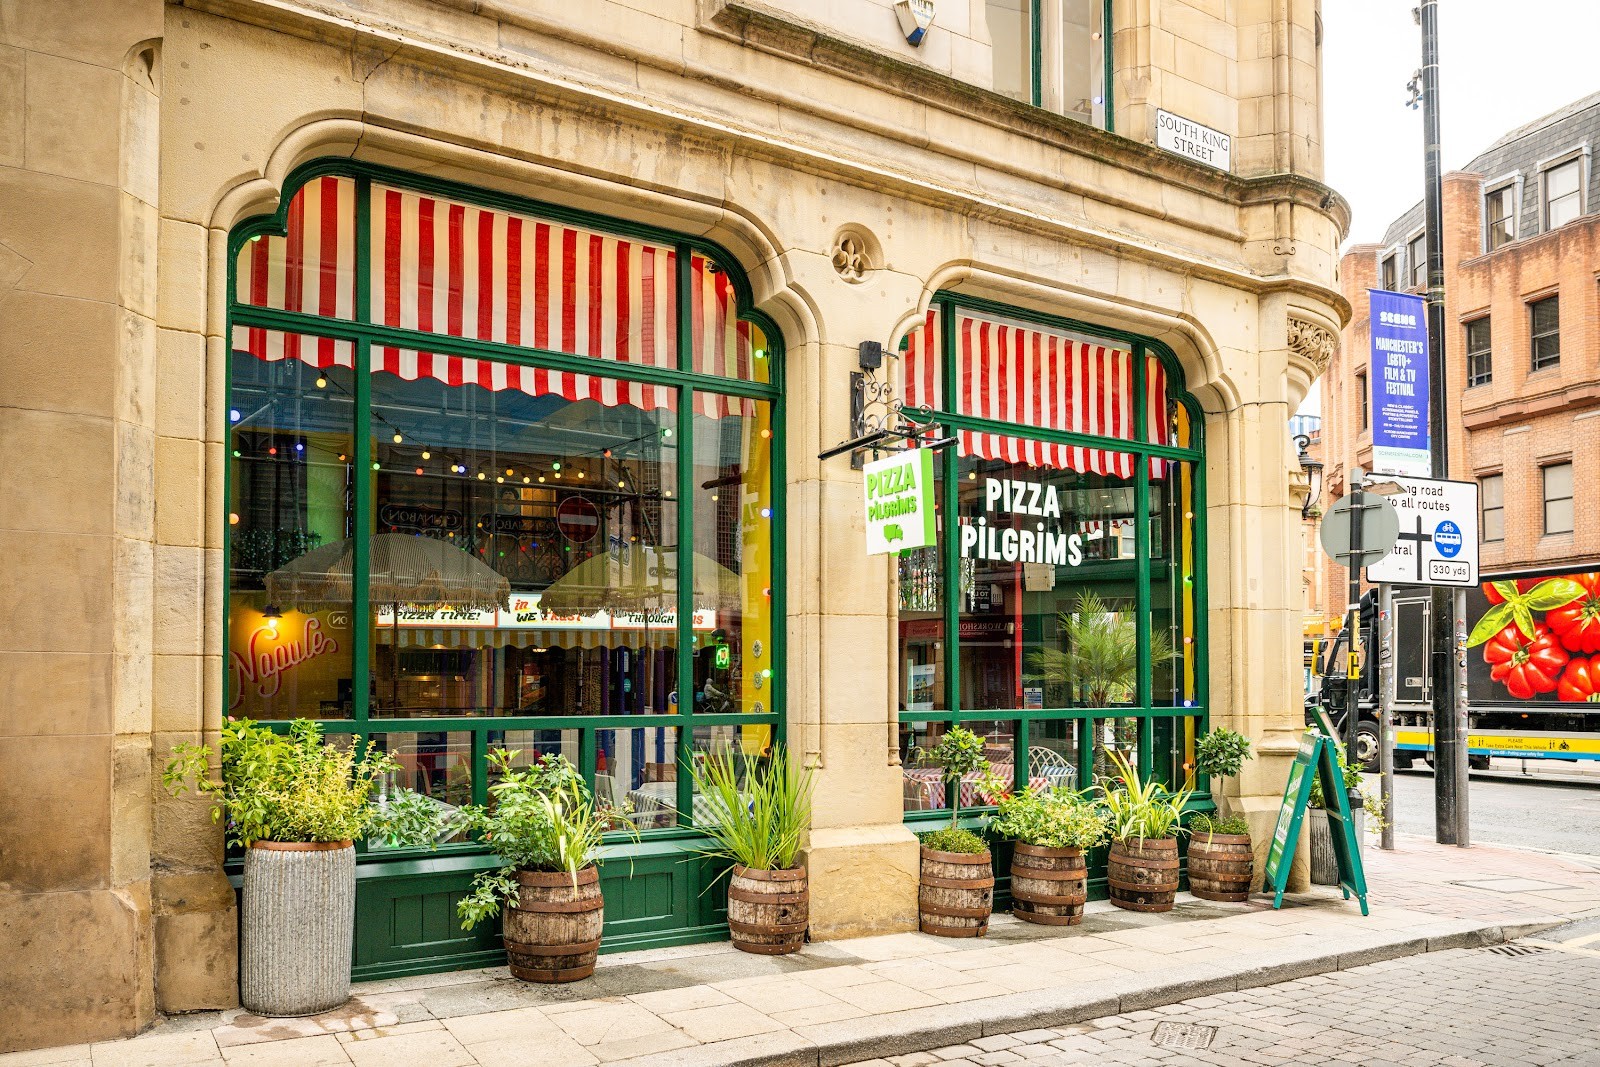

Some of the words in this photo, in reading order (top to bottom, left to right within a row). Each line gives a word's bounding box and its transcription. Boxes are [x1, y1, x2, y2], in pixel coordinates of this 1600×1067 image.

[1159, 114, 1198, 140] SOUTH
[1202, 130, 1229, 152] KING
[1173, 136, 1215, 162] STREET
[1375, 336, 1424, 354] MANCHESTER'S
[1387, 352, 1412, 369] LGBTQ+
[1384, 366, 1399, 381] FILM
[1400, 368, 1406, 382] &
[1406, 368, 1416, 382] TV
[1386, 381, 1415, 397] FESTIVAL
[867, 462, 916, 500] PIZZA
[986, 477, 1061, 518] PIZZA
[1406, 485, 1417, 496] ng
[1421, 486, 1443, 497] road
[1401, 497, 1414, 509] all
[1418, 500, 1450, 512] routes
[1389, 543, 1413, 556] tral
[1433, 565, 1450, 575] 330
[1452, 567, 1467, 577] yds
[440, 611, 481, 621] TIME!
[516, 612, 538, 623] WE
